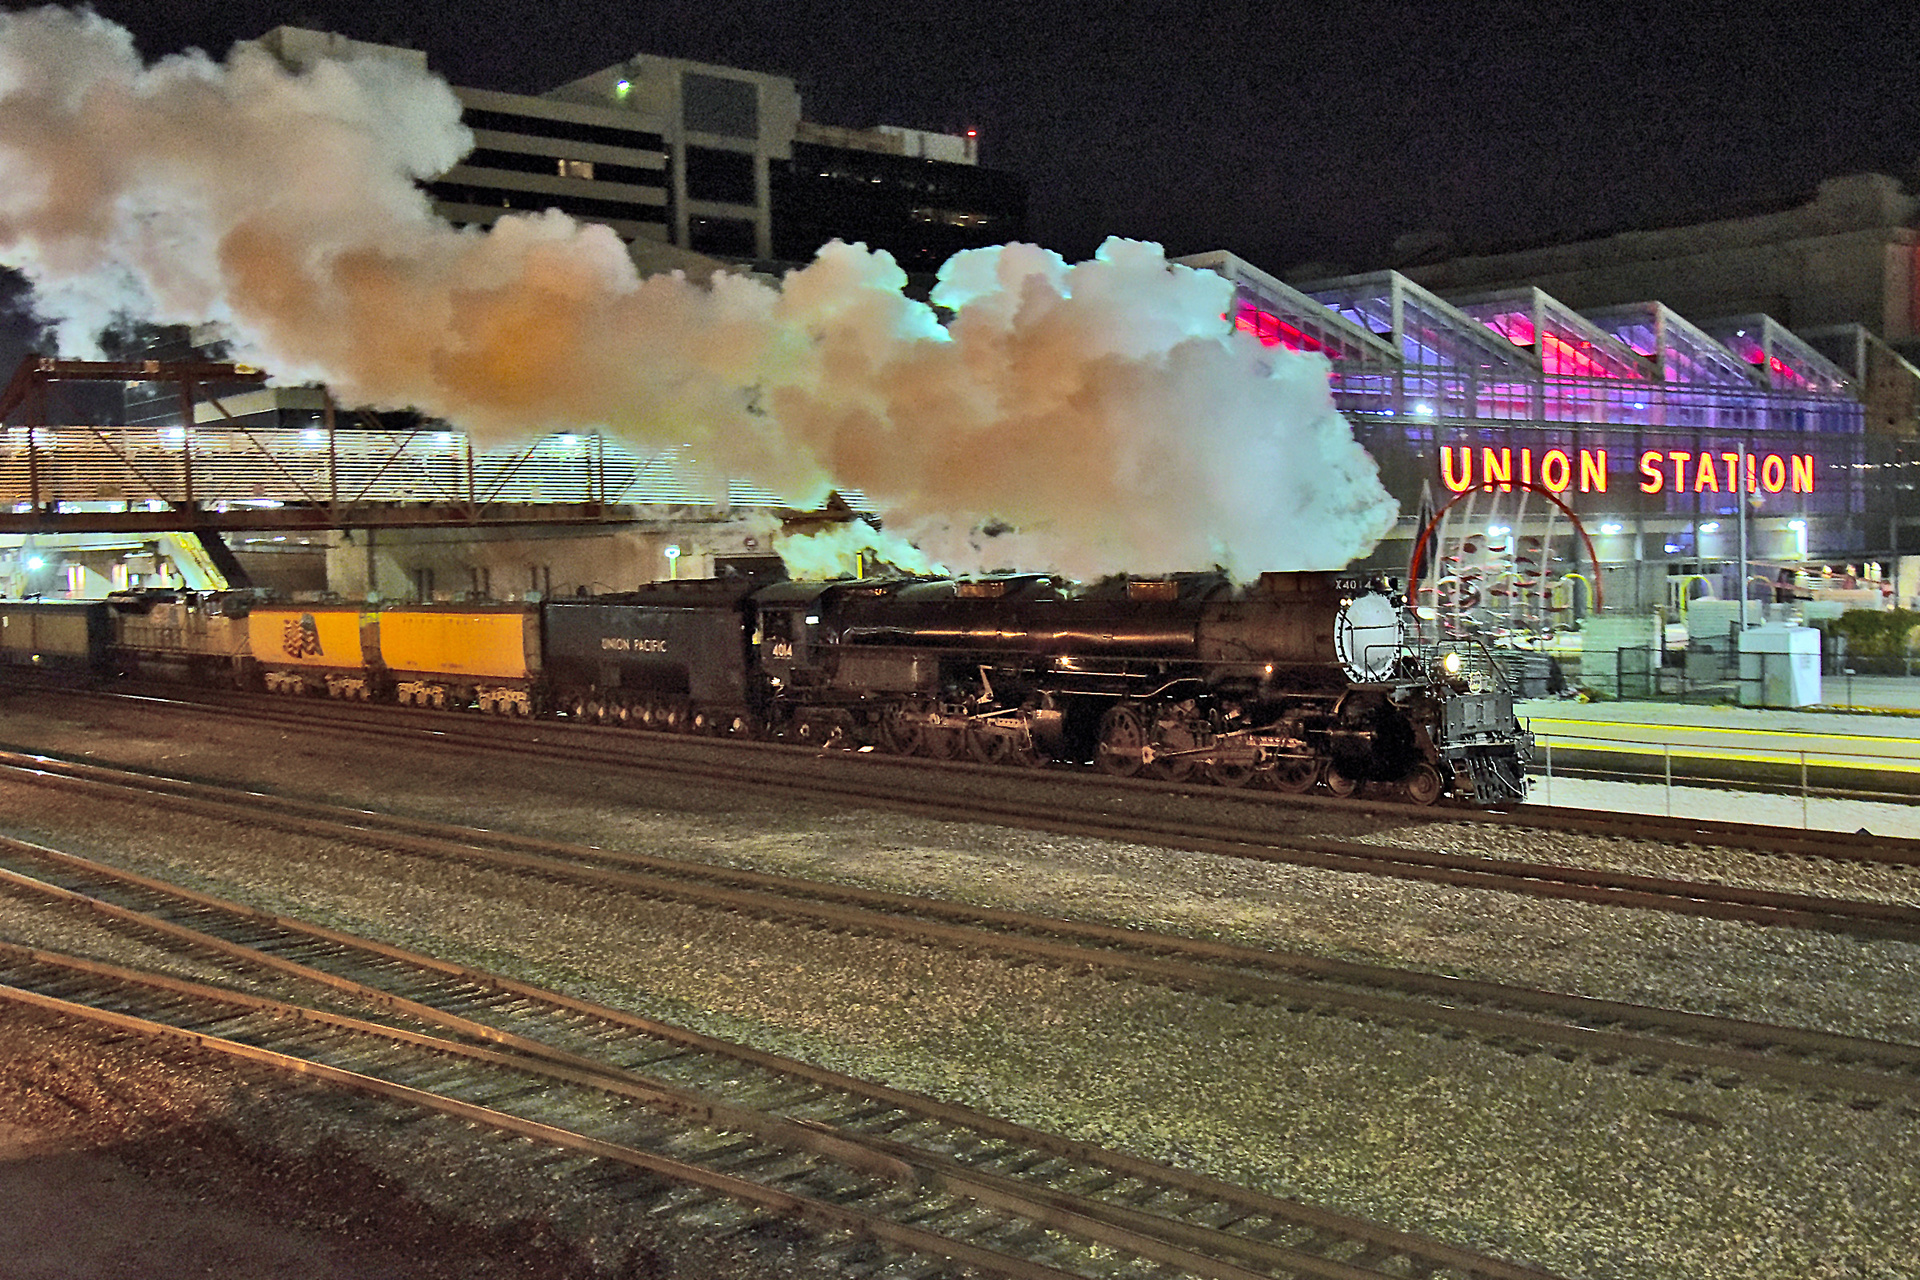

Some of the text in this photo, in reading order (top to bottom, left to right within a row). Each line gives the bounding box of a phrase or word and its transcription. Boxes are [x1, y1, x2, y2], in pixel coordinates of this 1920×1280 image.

[1439, 445, 1815, 495] UNION STATION
[1335, 579, 1372, 590] X4014
[601, 638, 668, 653] UNION PACIFIC
[772, 643, 793, 657] 4014
